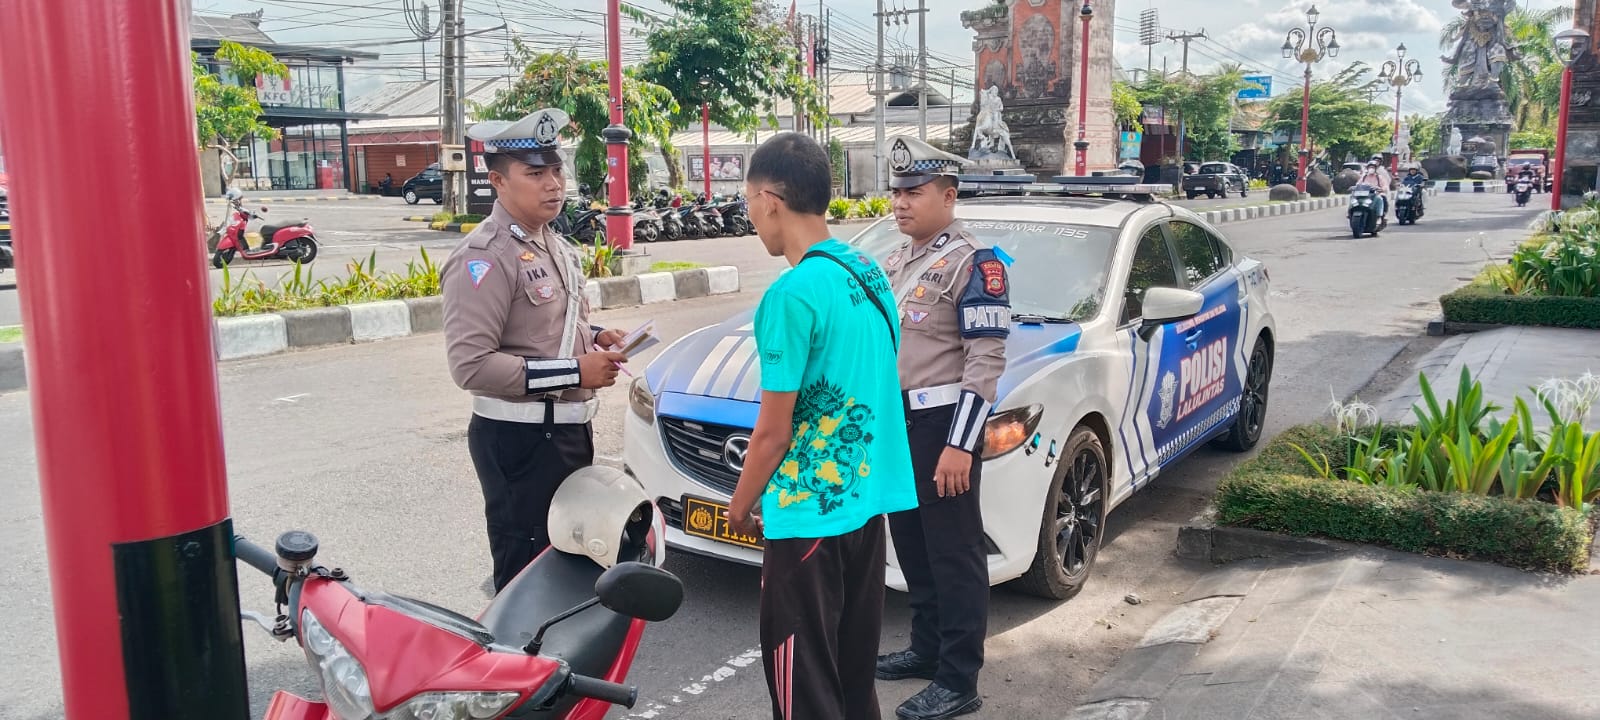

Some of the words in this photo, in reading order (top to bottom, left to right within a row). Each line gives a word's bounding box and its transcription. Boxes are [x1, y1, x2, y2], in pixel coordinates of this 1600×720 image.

[264, 92, 287, 102] KFC
[995, 222, 1046, 233] GIANYAR
[1053, 227, 1090, 239] 1135
[526, 267, 548, 282] IKA
[847, 266, 885, 289] CURSE
[920, 272, 943, 283] OLRI
[963, 305, 1011, 330] PATR
[1179, 335, 1228, 404] POLISI
[1175, 376, 1225, 423] LALULINTAS
